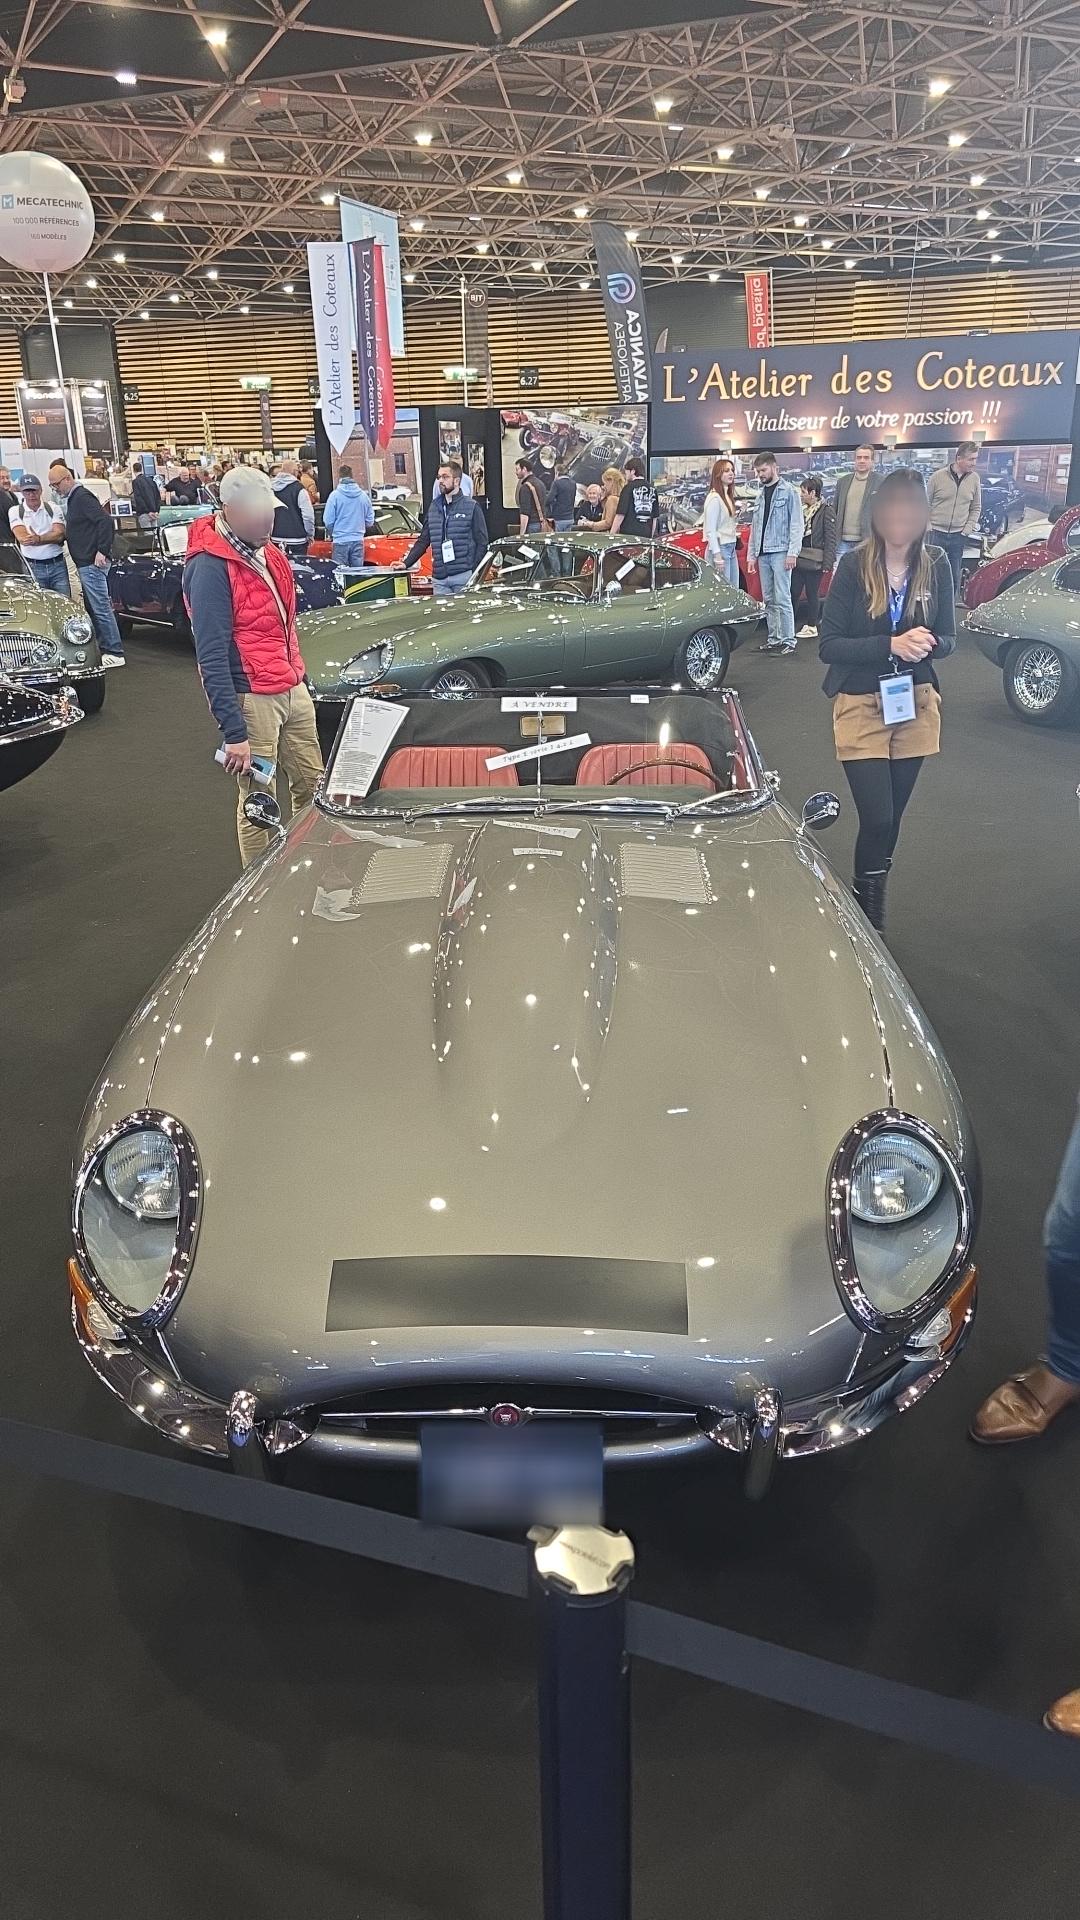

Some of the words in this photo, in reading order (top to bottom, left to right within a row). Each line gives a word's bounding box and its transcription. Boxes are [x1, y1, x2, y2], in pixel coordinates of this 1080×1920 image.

[16, 197, 84, 209] MECATECHNIC
[323, 254, 337, 316] Coteaux
[362, 250, 372, 323] L'Atelier
[470, 294, 483, 302] BJT
[325, 325, 339, 351] des
[366, 331, 374, 358] des
[309, 386, 320, 394] 6.2
[520, 377, 538, 386] 6.27
[663, 359, 812, 402] L'Atelier
[831, 354, 893, 395] des
[916, 351, 1064, 391] Coteaux
[326, 358, 343, 426] L'Atelier
[367, 365, 376, 427] Coteaux
[744, 408, 827, 432] Vitaliseur
[831, 406, 850, 429] de
[856, 410, 899, 427] votre
[903, 408, 974, 433] passion
[980, 400, 1002, 424] !!!
